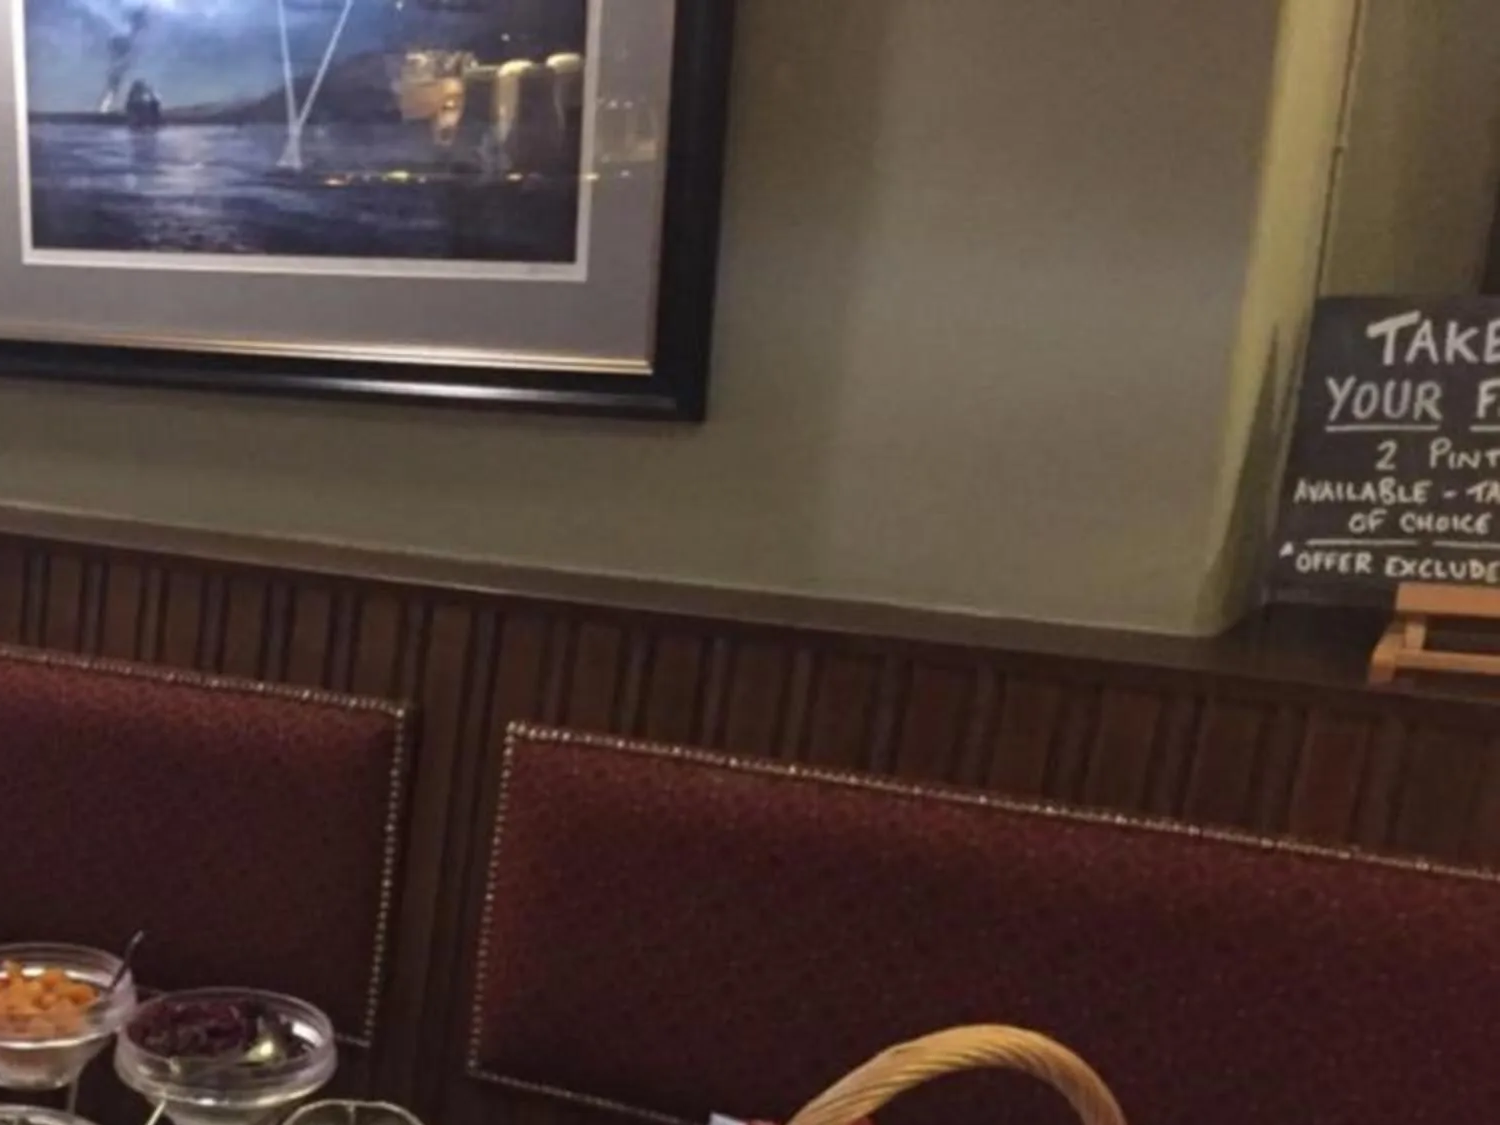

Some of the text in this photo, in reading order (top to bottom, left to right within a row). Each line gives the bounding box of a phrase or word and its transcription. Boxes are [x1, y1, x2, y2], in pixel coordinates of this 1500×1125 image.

[1366, 310, 1500, 366] TAKE
[1325, 375, 1500, 421] YOUR F
[1375, 436, 1500, 471] 2 PINT
[1293, 476, 1433, 506] AVAILABLE
[1349, 508, 1493, 536] OF CHOICE
